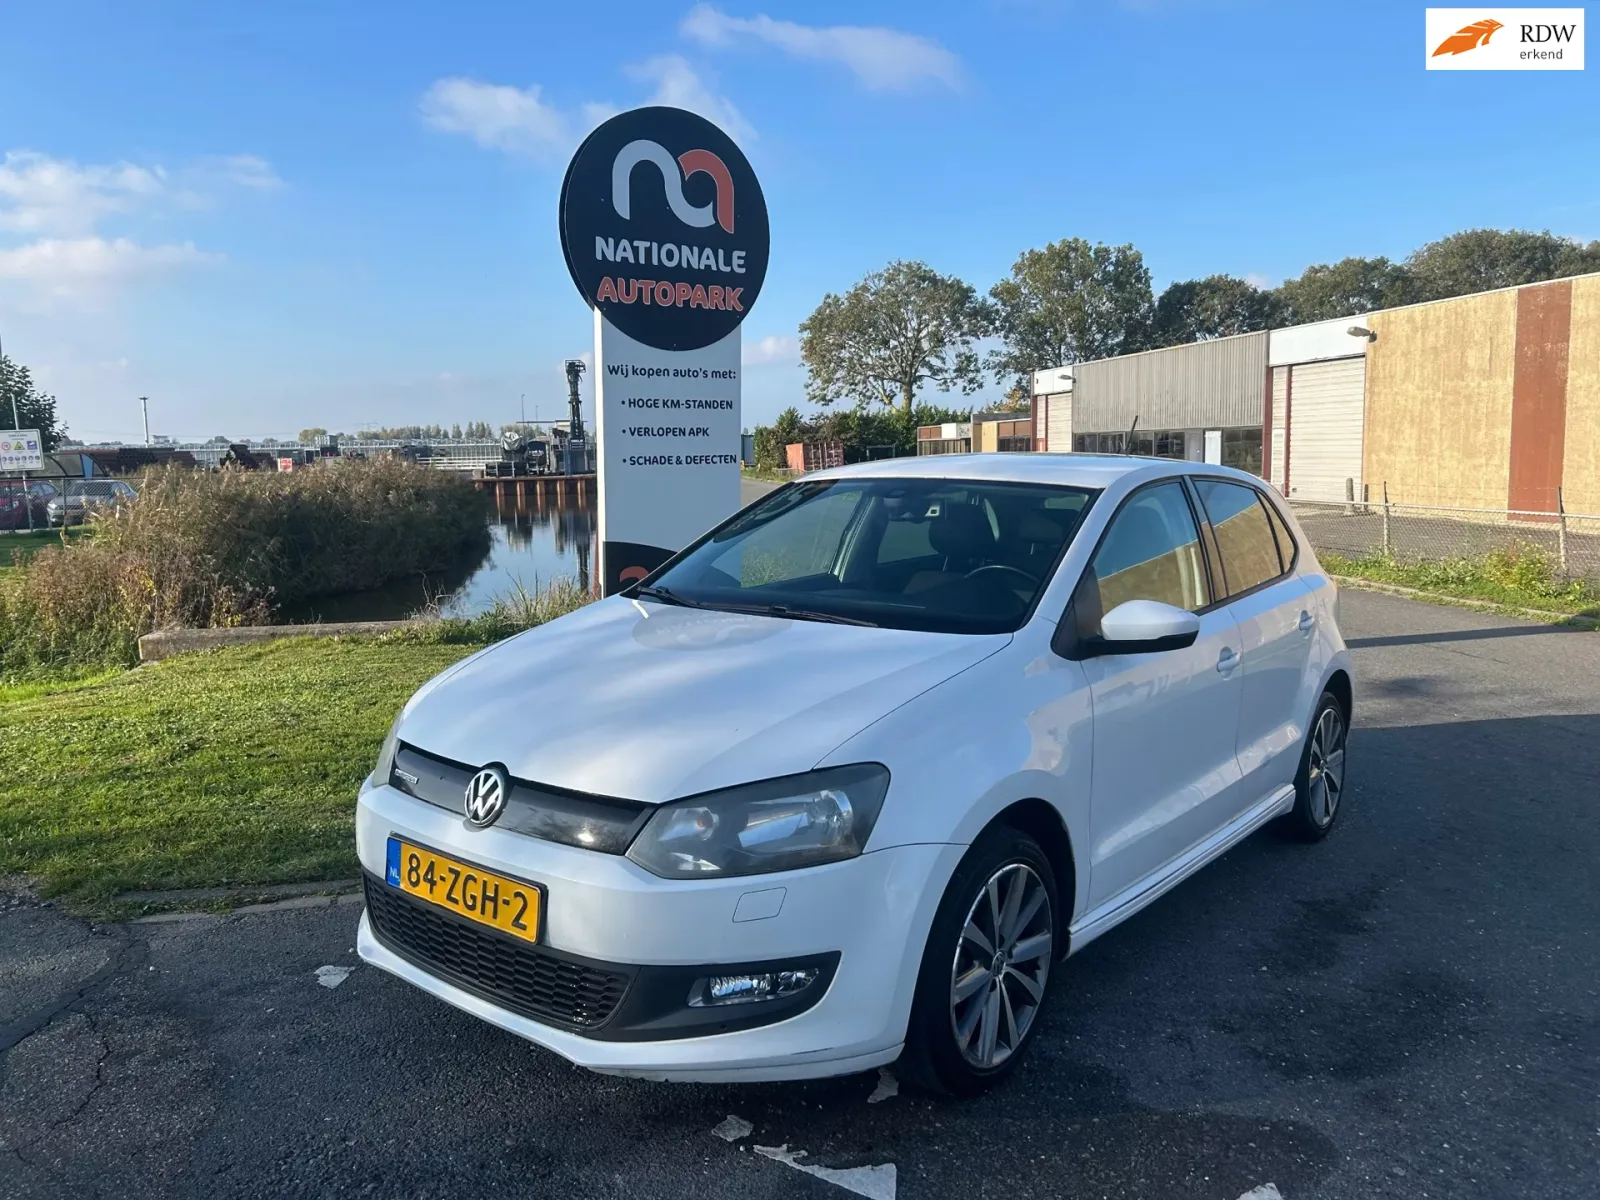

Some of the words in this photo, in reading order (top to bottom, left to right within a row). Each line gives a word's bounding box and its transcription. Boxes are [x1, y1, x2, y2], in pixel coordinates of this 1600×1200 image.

[595, 235, 746, 273] NATIONALE
[596, 276, 744, 311] AUTOPARK
[607, 364, 629, 378] Wij
[631, 365, 670, 378] kopen
[672, 367, 709, 379] auto's
[711, 369, 737, 379] met:
[628, 398, 660, 409] HOGE
[662, 399, 733, 410] KM-STANDEN
[628, 426, 686, 437] VERLOPEN
[688, 427, 710, 437] APK
[629, 455, 674, 466] SCHADE
[675, 455, 684, 465] &
[685, 454, 737, 465] DEFECTEN
[406, 852, 529, 932] 84-ZGH-2
